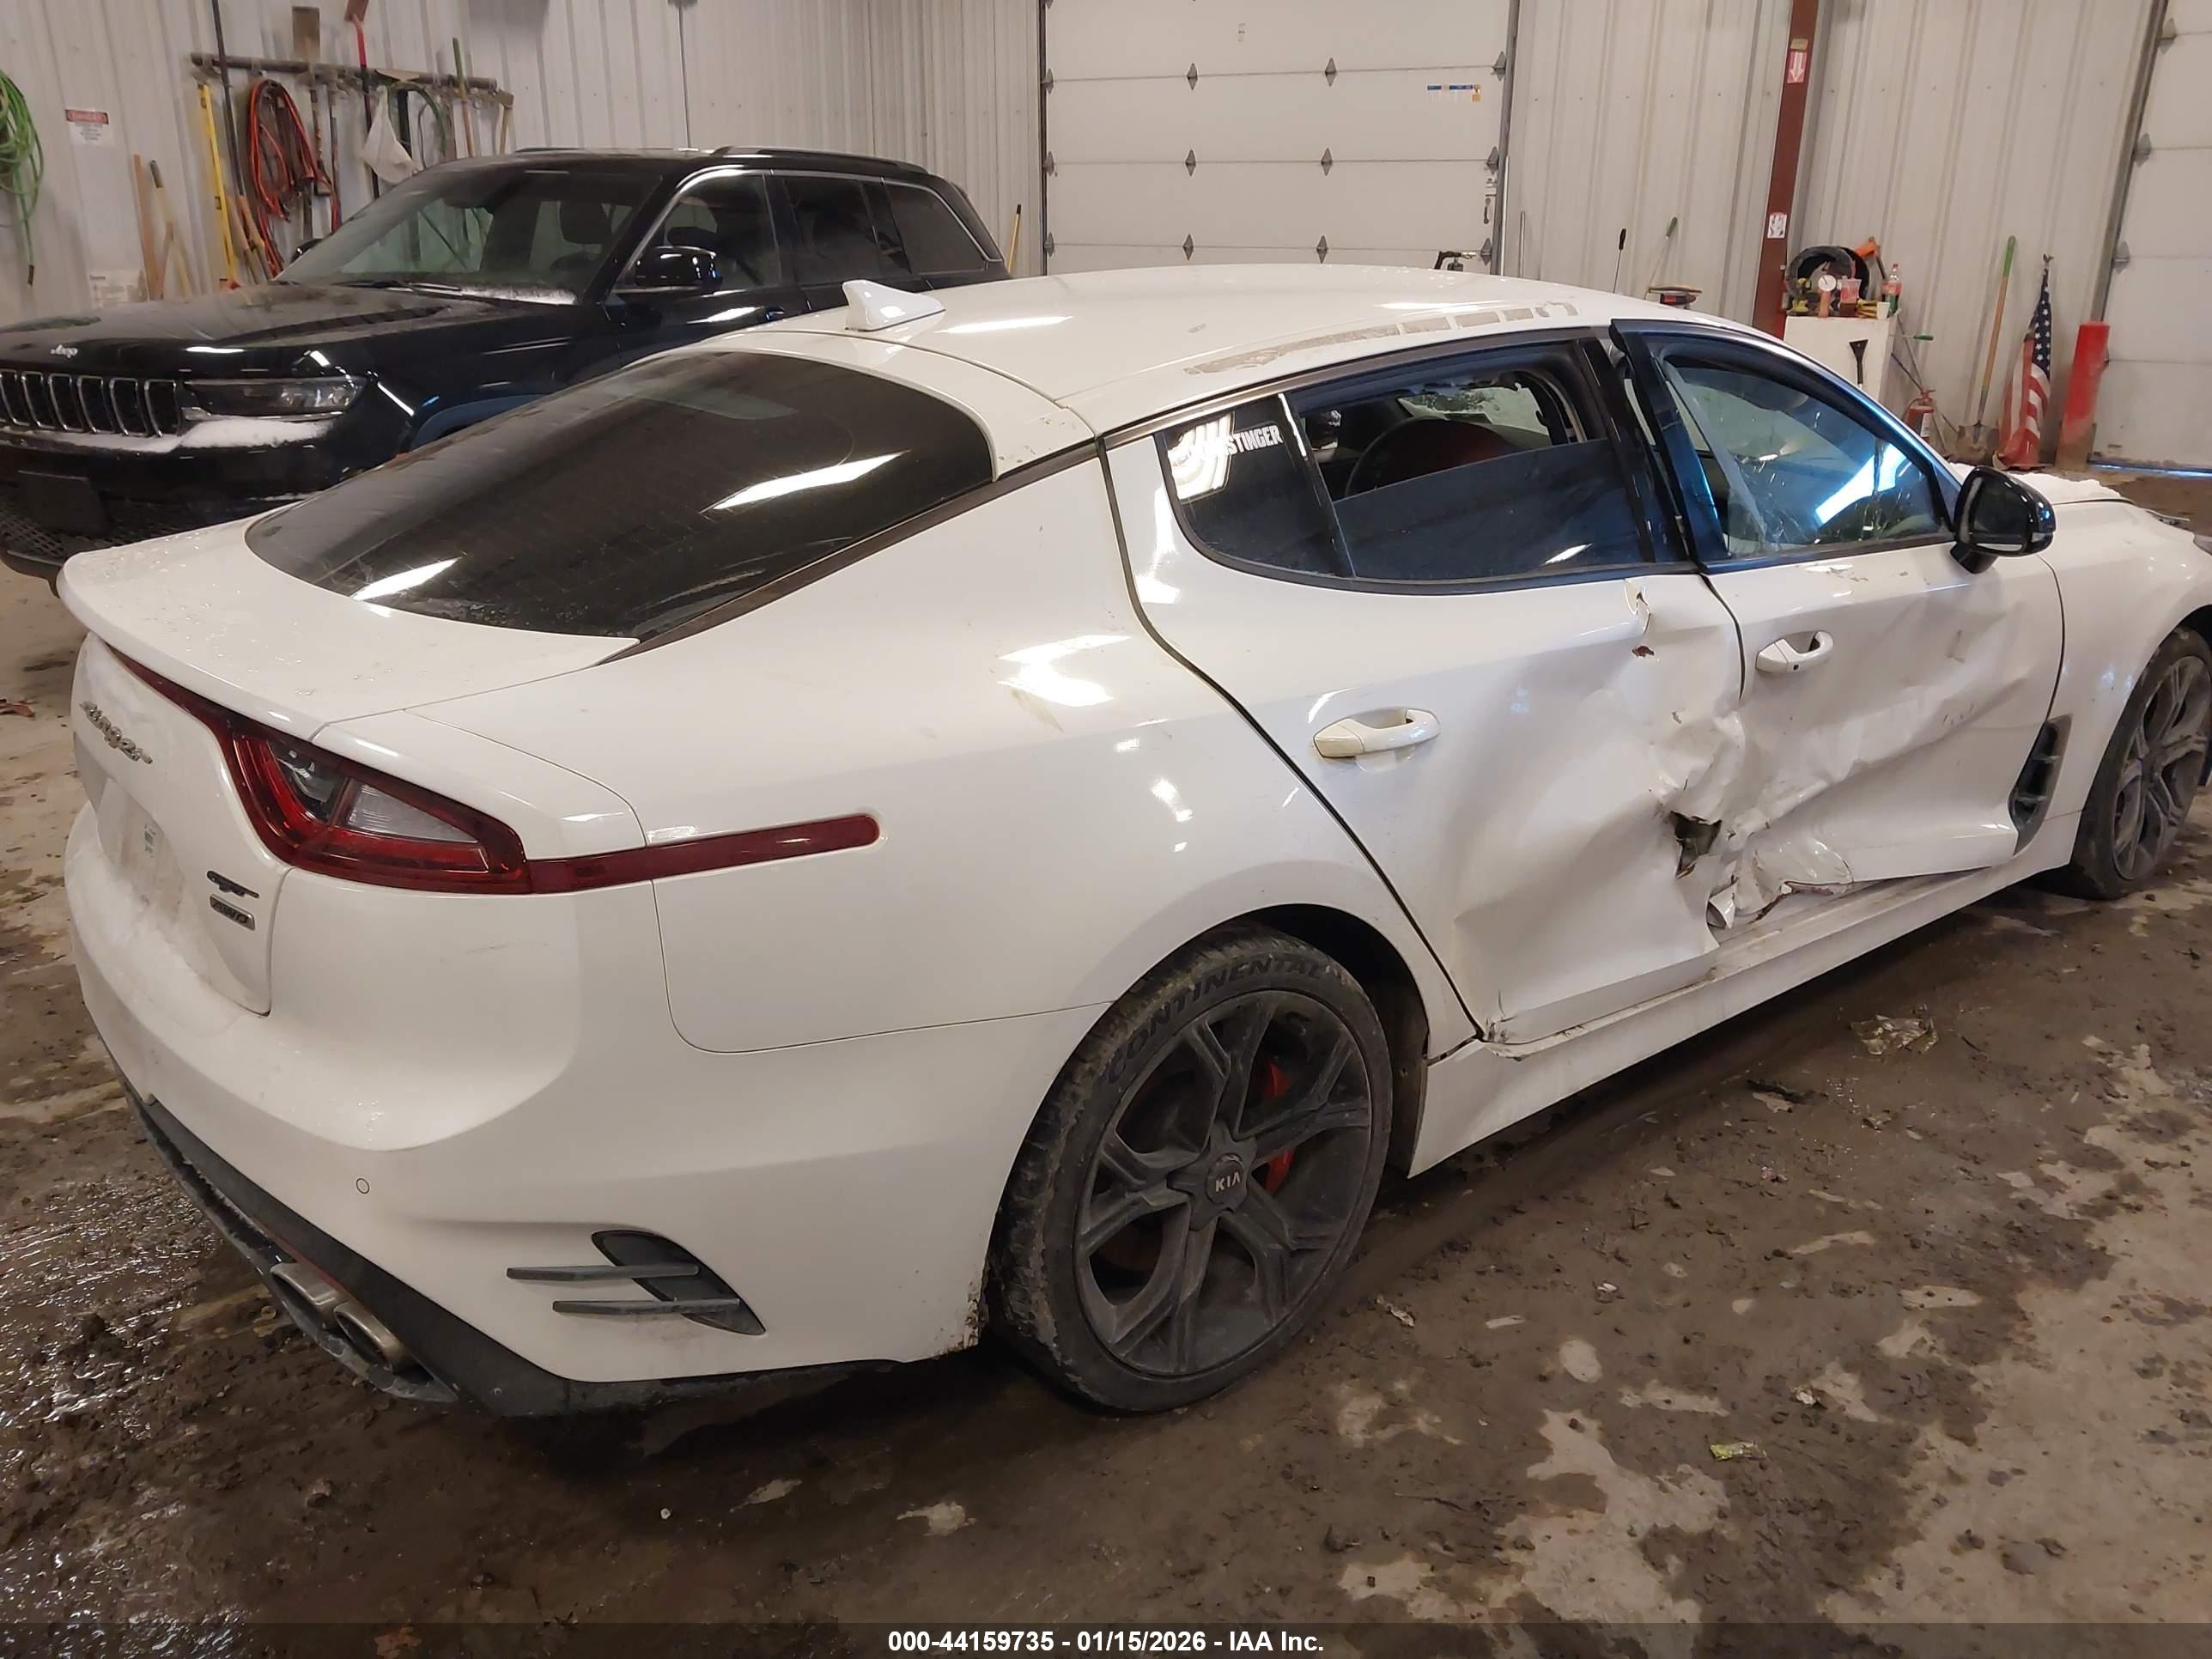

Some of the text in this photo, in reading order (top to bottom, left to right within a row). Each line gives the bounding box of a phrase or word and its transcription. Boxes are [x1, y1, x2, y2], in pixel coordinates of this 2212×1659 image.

[1228, 425, 1283, 455] STINGER
[212, 897, 250, 925] AWD
[1105, 956, 1321, 1083] CONTINENTAL
[1215, 1171, 1240, 1192] KIA
